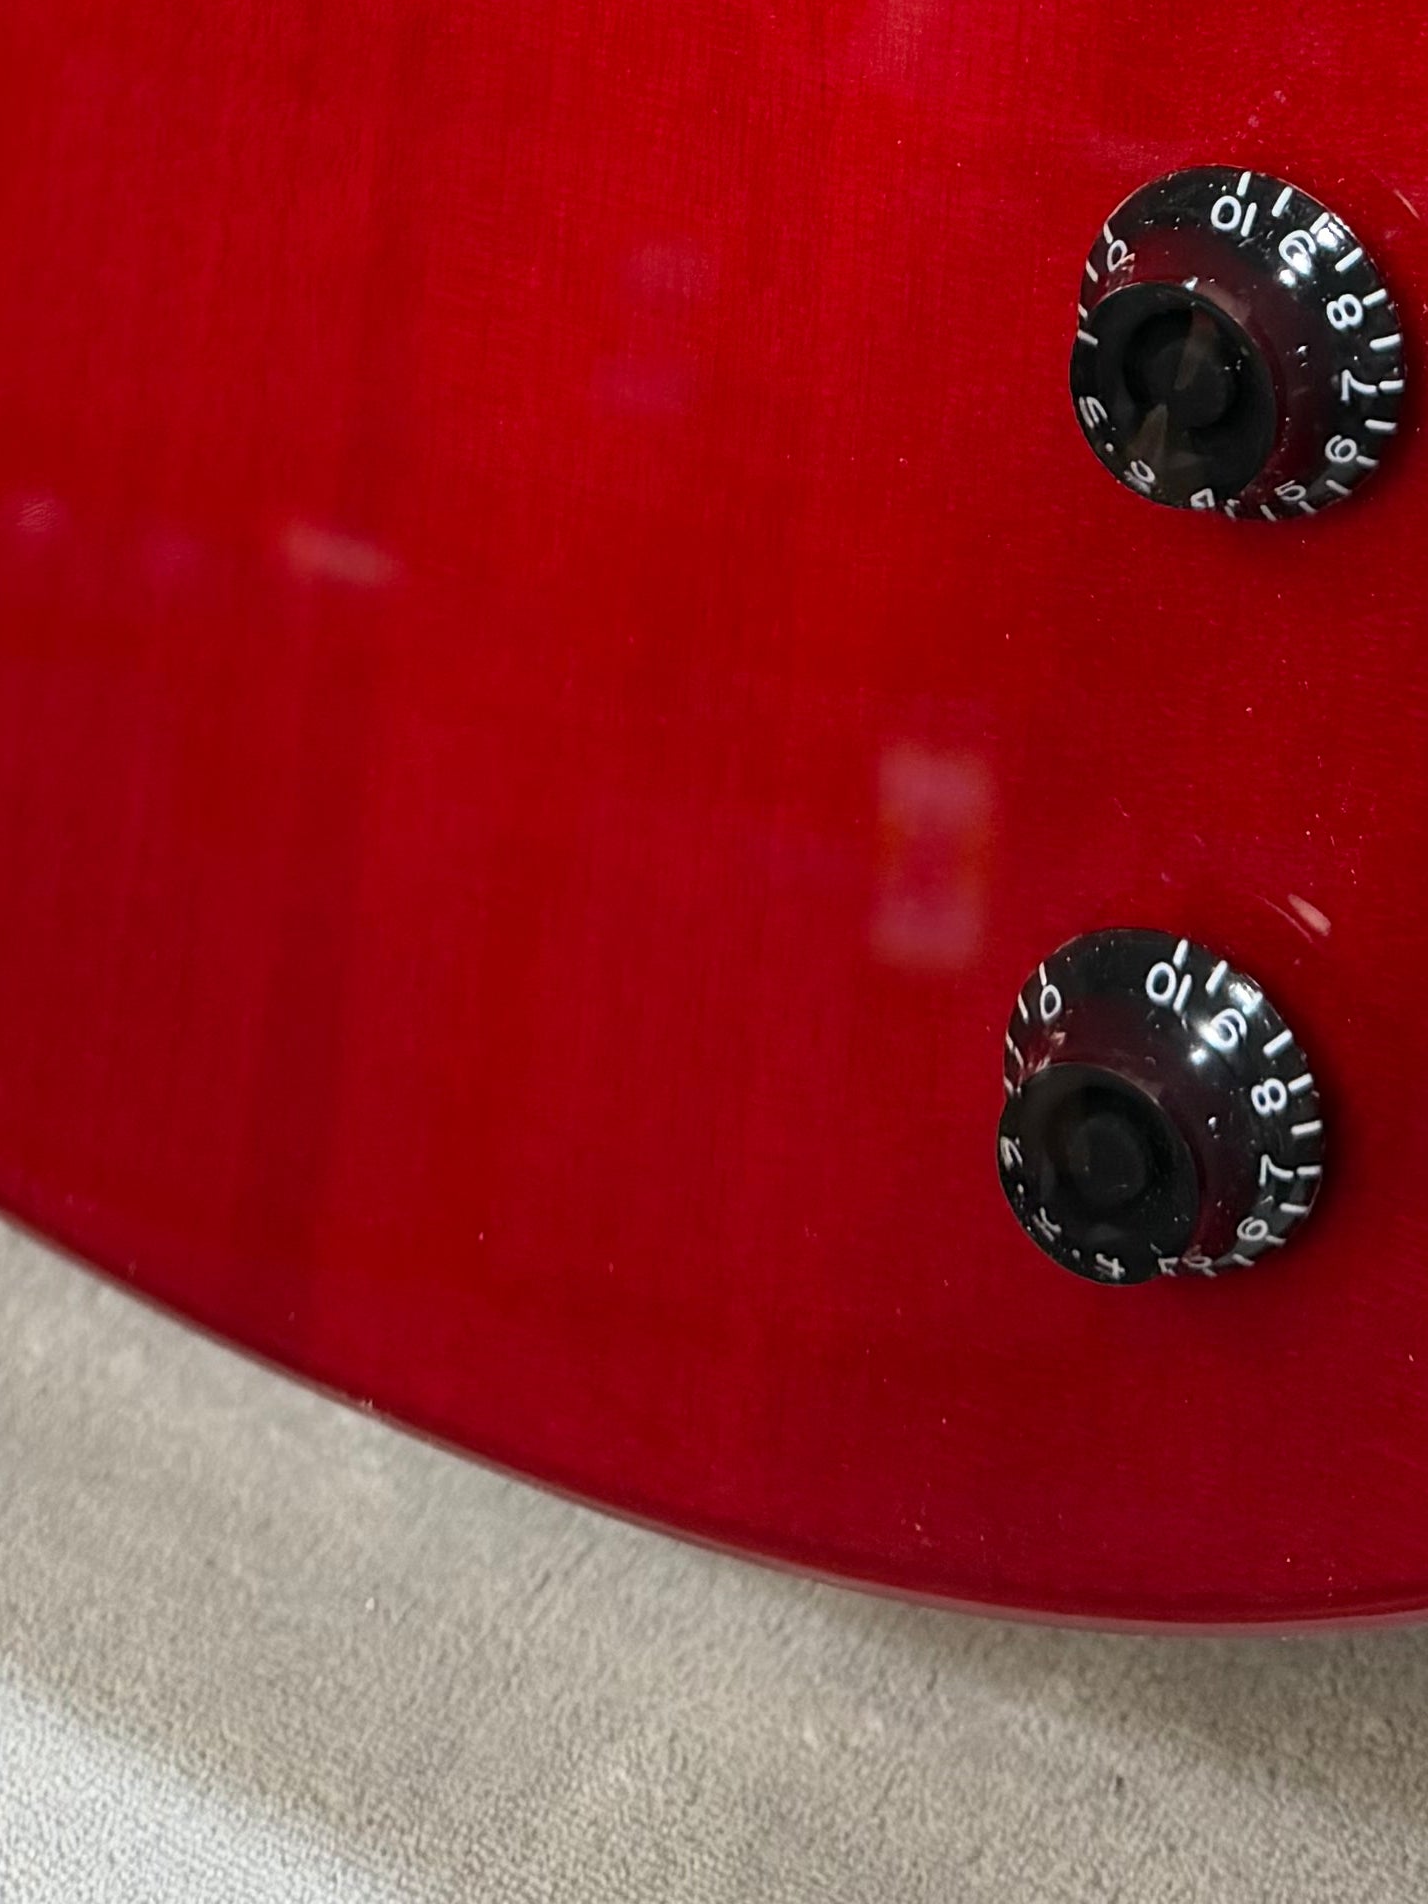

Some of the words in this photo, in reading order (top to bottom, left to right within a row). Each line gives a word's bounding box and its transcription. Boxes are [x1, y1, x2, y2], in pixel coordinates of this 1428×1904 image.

[1210, 195, 1258, 237] 10
[1326, 293, 1364, 332] 8
[1340, 369, 1377, 404] 7
[1039, 984, 1062, 1022] 0
[1145, 961, 1193, 1012] 10
[1251, 1078, 1288, 1115] 8
[1259, 1153, 1295, 1186] 7
